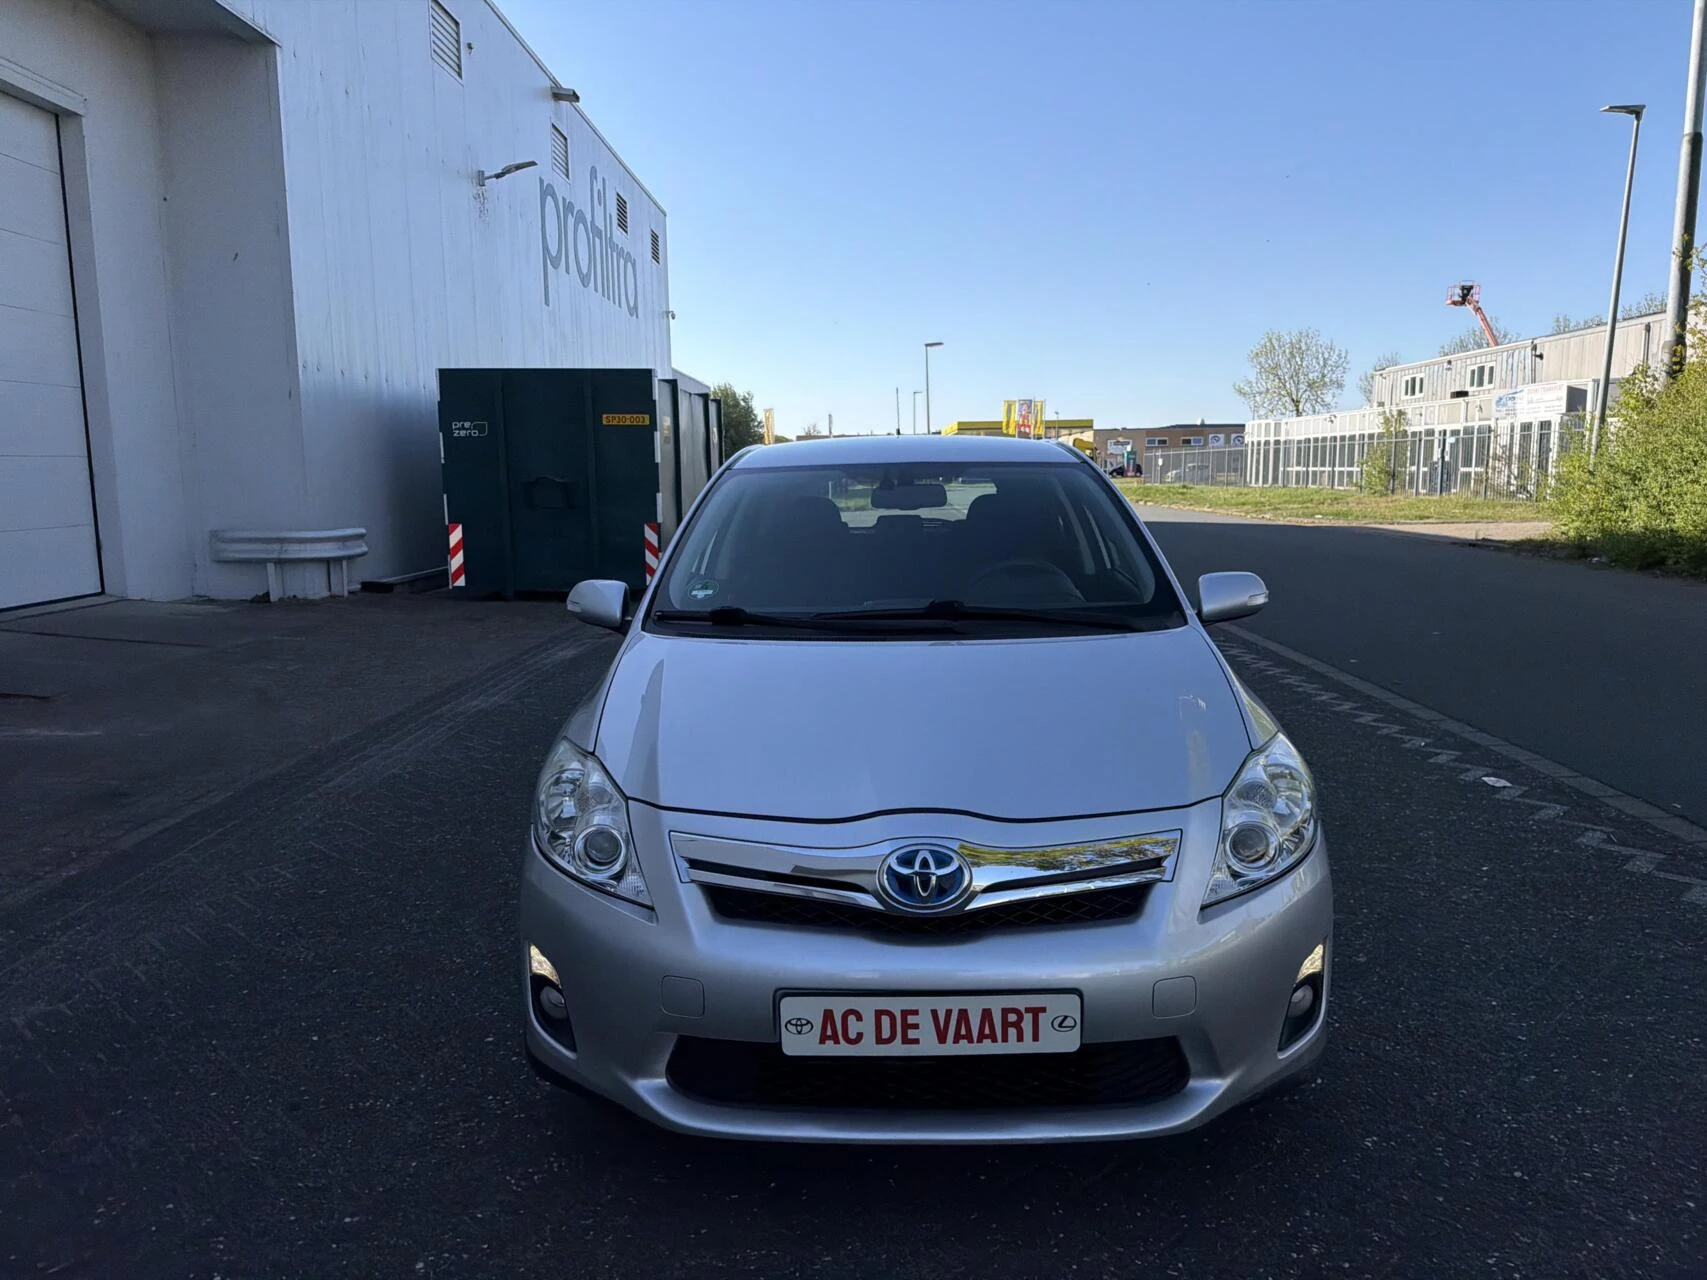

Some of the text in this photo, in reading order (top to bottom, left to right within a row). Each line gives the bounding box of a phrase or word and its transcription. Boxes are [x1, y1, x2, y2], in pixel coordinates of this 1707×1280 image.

[539, 165, 639, 319] profiltra
[452, 421, 471, 429] pre
[453, 429, 479, 437] zero
[818, 1006, 1047, 1045] AC DE VAART
